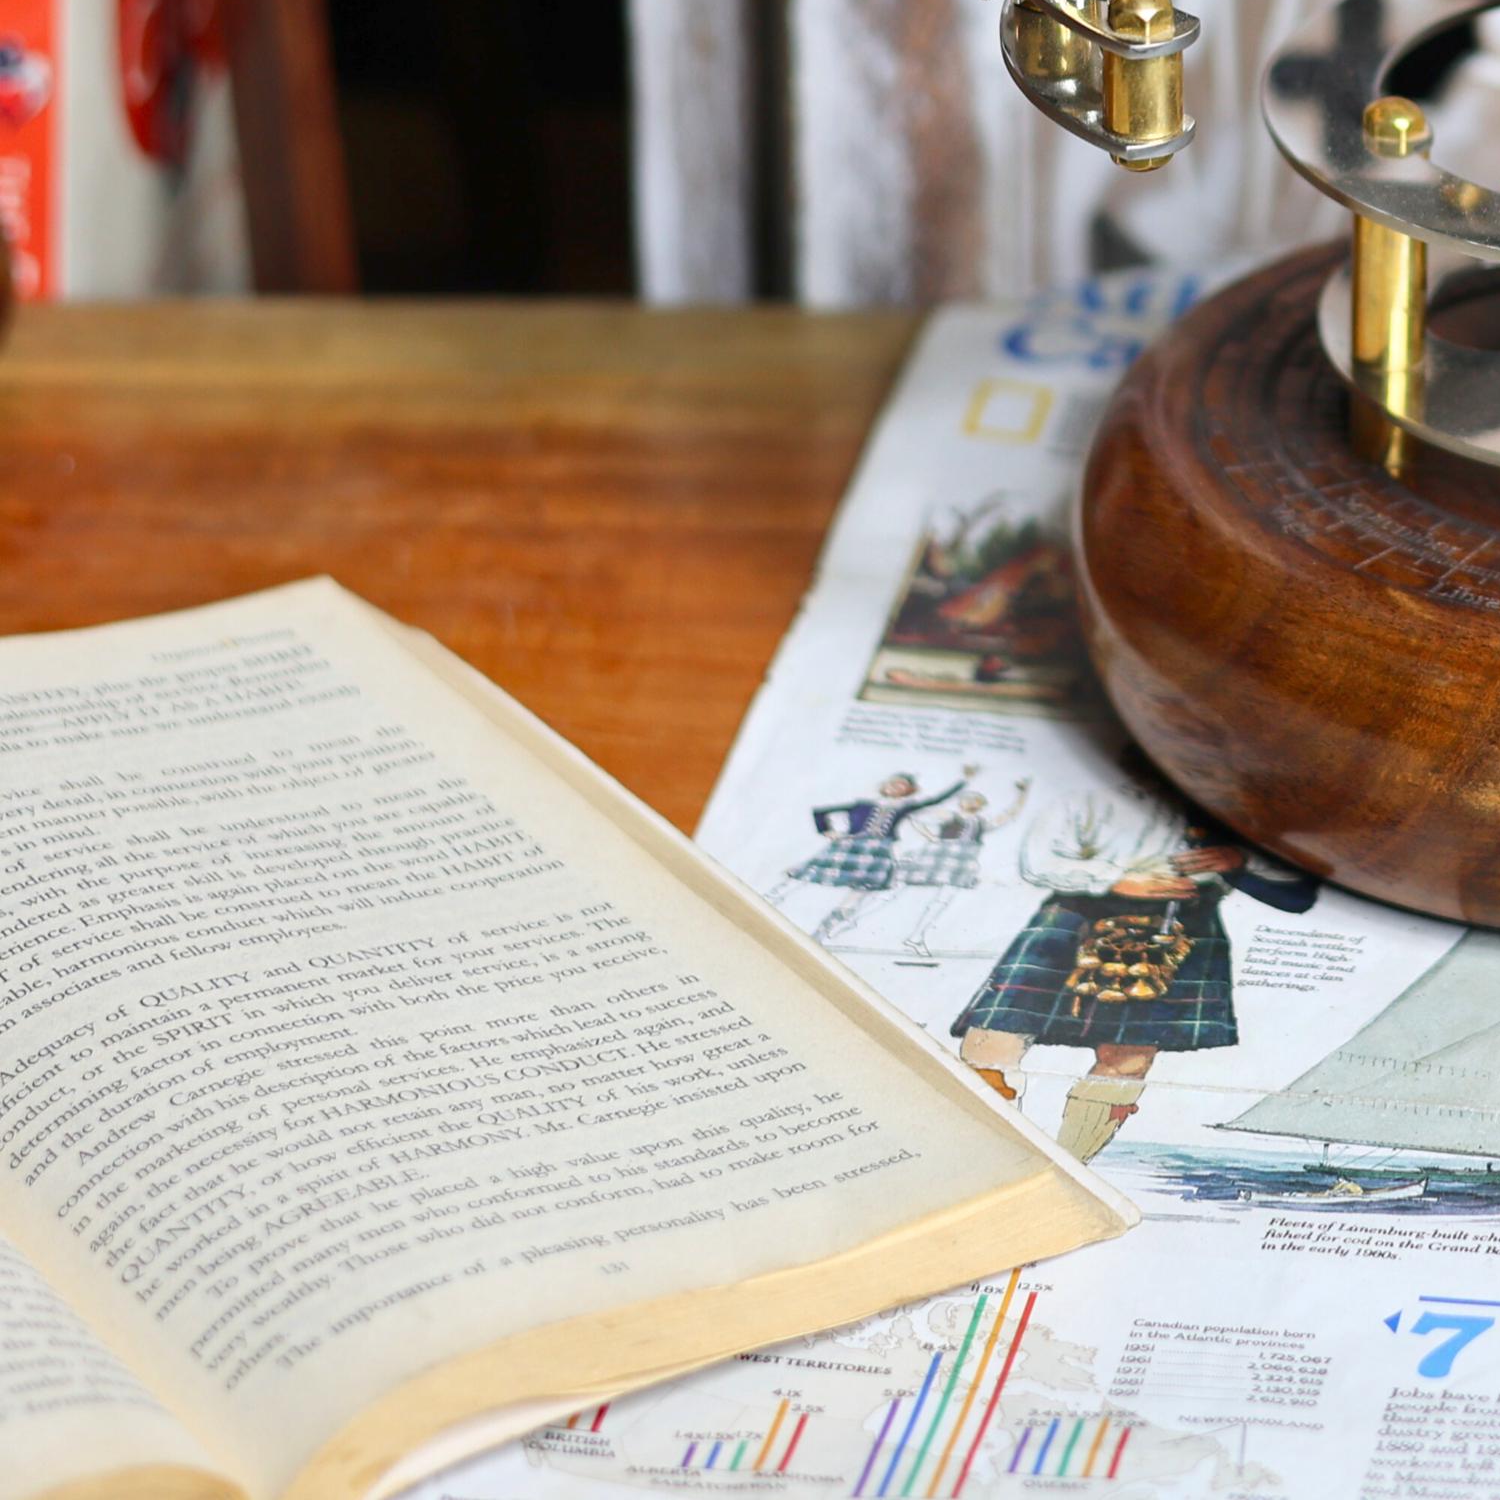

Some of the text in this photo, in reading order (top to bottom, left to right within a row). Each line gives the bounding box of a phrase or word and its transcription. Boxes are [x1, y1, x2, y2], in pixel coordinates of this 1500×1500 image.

[1244, 954, 1279, 965] land
[1280, 961, 1322, 970] music
[1241, 966, 1291, 978] dances
[1312, 972, 1343, 982] clan
[0, 902, 615, 1089] Adequacy of QUALITY and QUANTITY of service is not
[80, 1064, 105, 1081] or
[112, 1045, 148, 1065] the
[151, 1012, 234, 1046] SPIRIT
[240, 1009, 266, 1020] in
[271, 993, 336, 1012] which
[342, 986, 382, 1002] you
[388, 972, 456, 991] deliver
[462, 959, 539, 977] service,
[539, 952, 560, 963] is
[566, 949, 581, 957] a
[585, 931, 652, 953] strong
[8, 947, 668, 1170] determining factor in connection with both the price you receive,
[1269, 1218, 1314, 1228] Fleets
[1317, 1222, 1335, 1233] of
[1261, 1242, 1276, 1250] in
[1281, 1242, 1304, 1251] the
[1308, 1245, 1350, 1256] early
[1264, 1229, 1313, 1240] fished
[1314, 1231, 1337, 1242] for
[1342, 1237, 1373, 1245] cod
[1399, 1240, 1423, 1249] the
[1427, 1242, 1482, 1253] Grand
[1017, 1282, 1053, 1292] 12.5%
[1133, 1319, 1315, 1339] Canadian population born
[1130, 1330, 1305, 1350] in the Atlantic provinces
[1411, 1311, 1495, 1378] 7
[786, 1356, 892, 1375] TERRITORIES
